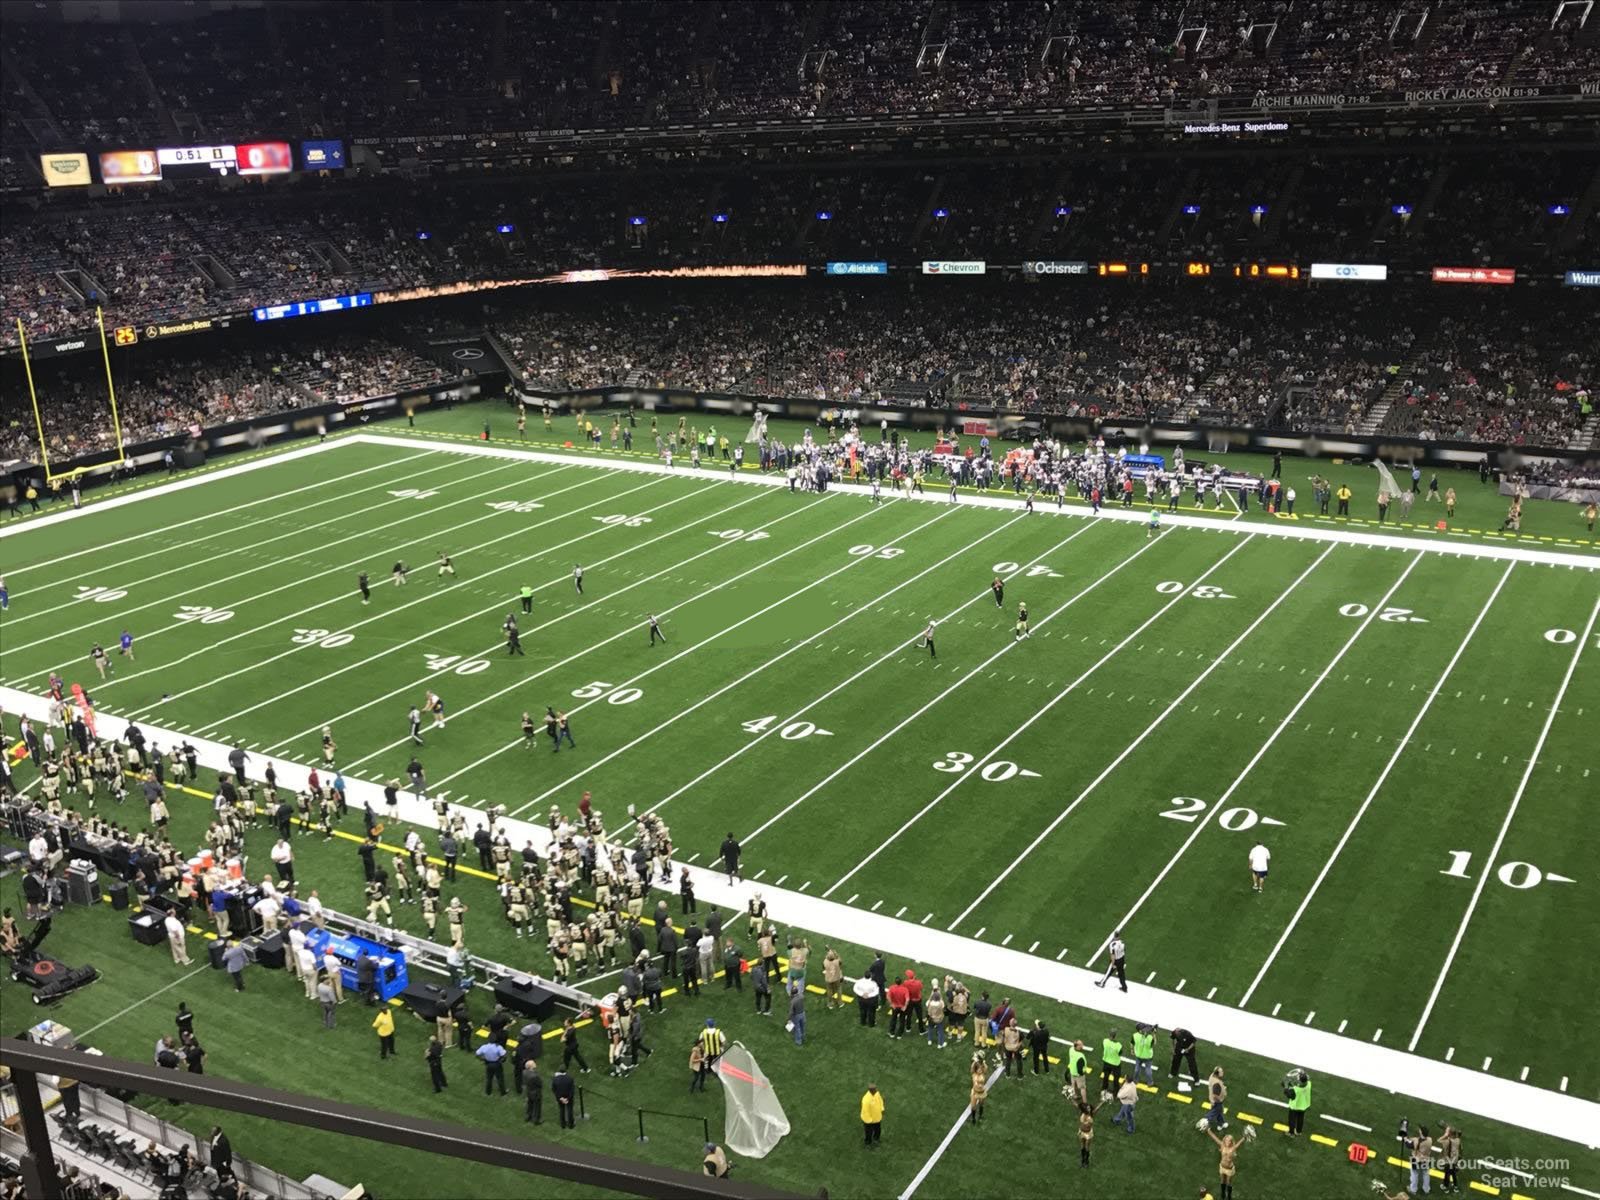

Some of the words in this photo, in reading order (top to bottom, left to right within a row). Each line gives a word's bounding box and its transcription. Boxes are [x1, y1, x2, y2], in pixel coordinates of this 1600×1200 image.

[1251, 97, 1291, 108] ARCHIE
[1293, 94, 1345, 105] MANNING
[1347, 95, 1371, 104] 71-82
[1405, 90, 1449, 101] RICKEY
[1452, 87, 1511, 100] JACKSON
[1513, 88, 1540, 97] 81-93
[1184, 124, 1241, 133] Mercedes-Benz
[1244, 122, 1289, 132] Superdome
[176, 150, 202, 161] 0:51
[847, 262, 879, 273] Allstate
[942, 262, 980, 273] Chevron
[1035, 261, 1082, 274] Ochsner
[1335, 267, 1359, 276] COX
[159, 320, 212, 335] Mercedes-Benz
[117, 328, 135, 344] 25
[55, 340, 85, 352] verizon
[847, 544, 906, 559] 50
[991, 561, 1053, 577] 40
[1155, 581, 1223, 599] 30
[173, 605, 235, 624] 20
[1338, 603, 1415, 622] 20
[291, 628, 355, 648] 30
[424, 654, 491, 675] 40
[571, 681, 644, 705] 50
[741, 715, 816, 740] 40
[932, 751, 1018, 781] 30
[1158, 796, 1259, 831] 20
[1438, 849, 1543, 889] 10
[1352, 1145, 1366, 1162] 10
